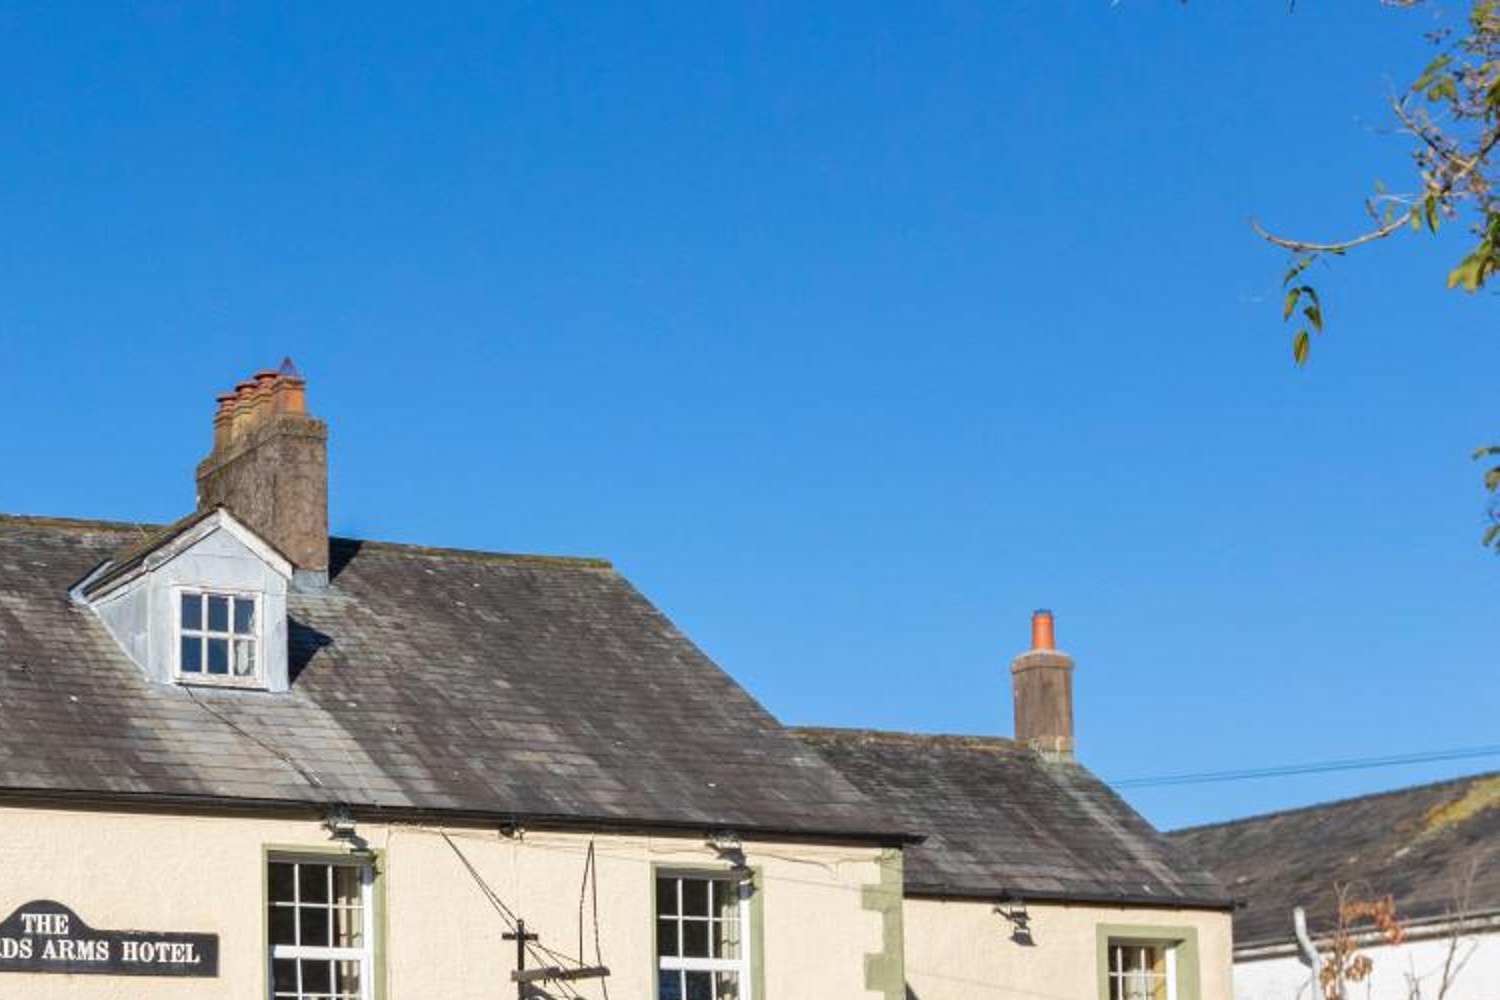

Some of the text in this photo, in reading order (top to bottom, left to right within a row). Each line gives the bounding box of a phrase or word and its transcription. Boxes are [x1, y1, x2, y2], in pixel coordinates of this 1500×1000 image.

[21, 913, 69, 935] THE
[41, 939, 109, 961] ARMS
[122, 941, 200, 964] HOTEL
